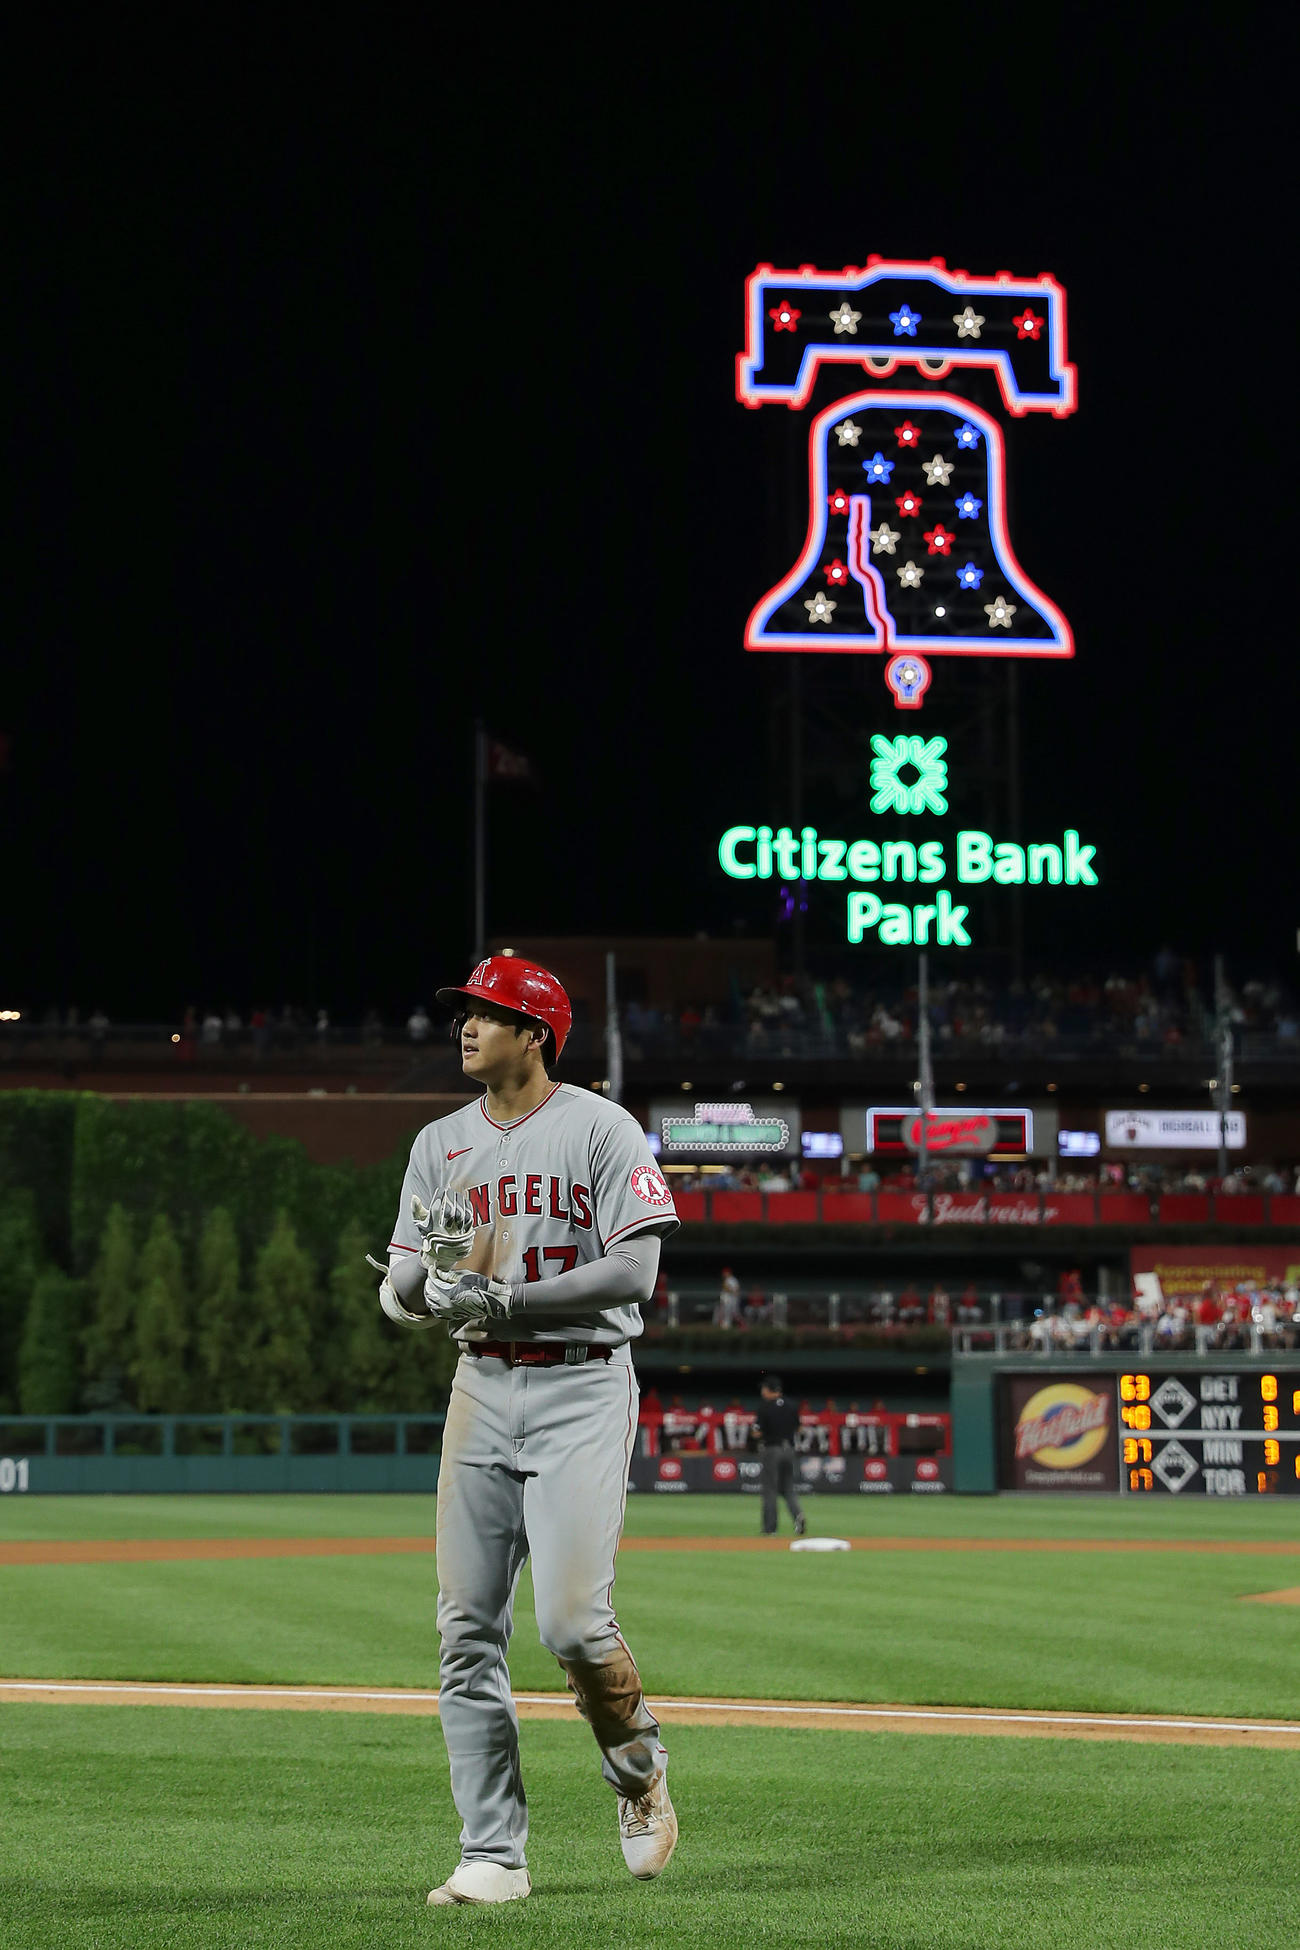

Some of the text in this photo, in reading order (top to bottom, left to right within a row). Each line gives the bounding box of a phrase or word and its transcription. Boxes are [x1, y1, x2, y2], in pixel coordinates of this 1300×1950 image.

[718, 826, 1099, 886] Citizens Bank
[847, 890, 972, 946] Park
[467, 1173, 594, 1231] NGELS
[911, 1193, 1059, 1225] Budweiser
[522, 1245, 579, 1283] 17
[1120, 1375, 1150, 1401] 63
[1201, 1375, 1241, 1401] DET
[1201, 1405, 1243, 1431] NYY
[1263, 1405, 1279, 1432] 3
[1123, 1438, 1152, 1464] 37
[1202, 1439, 1244, 1466] MIN
[1264, 1439, 1280, 1466] 3
[1202, 1468, 1247, 1496] TOR
